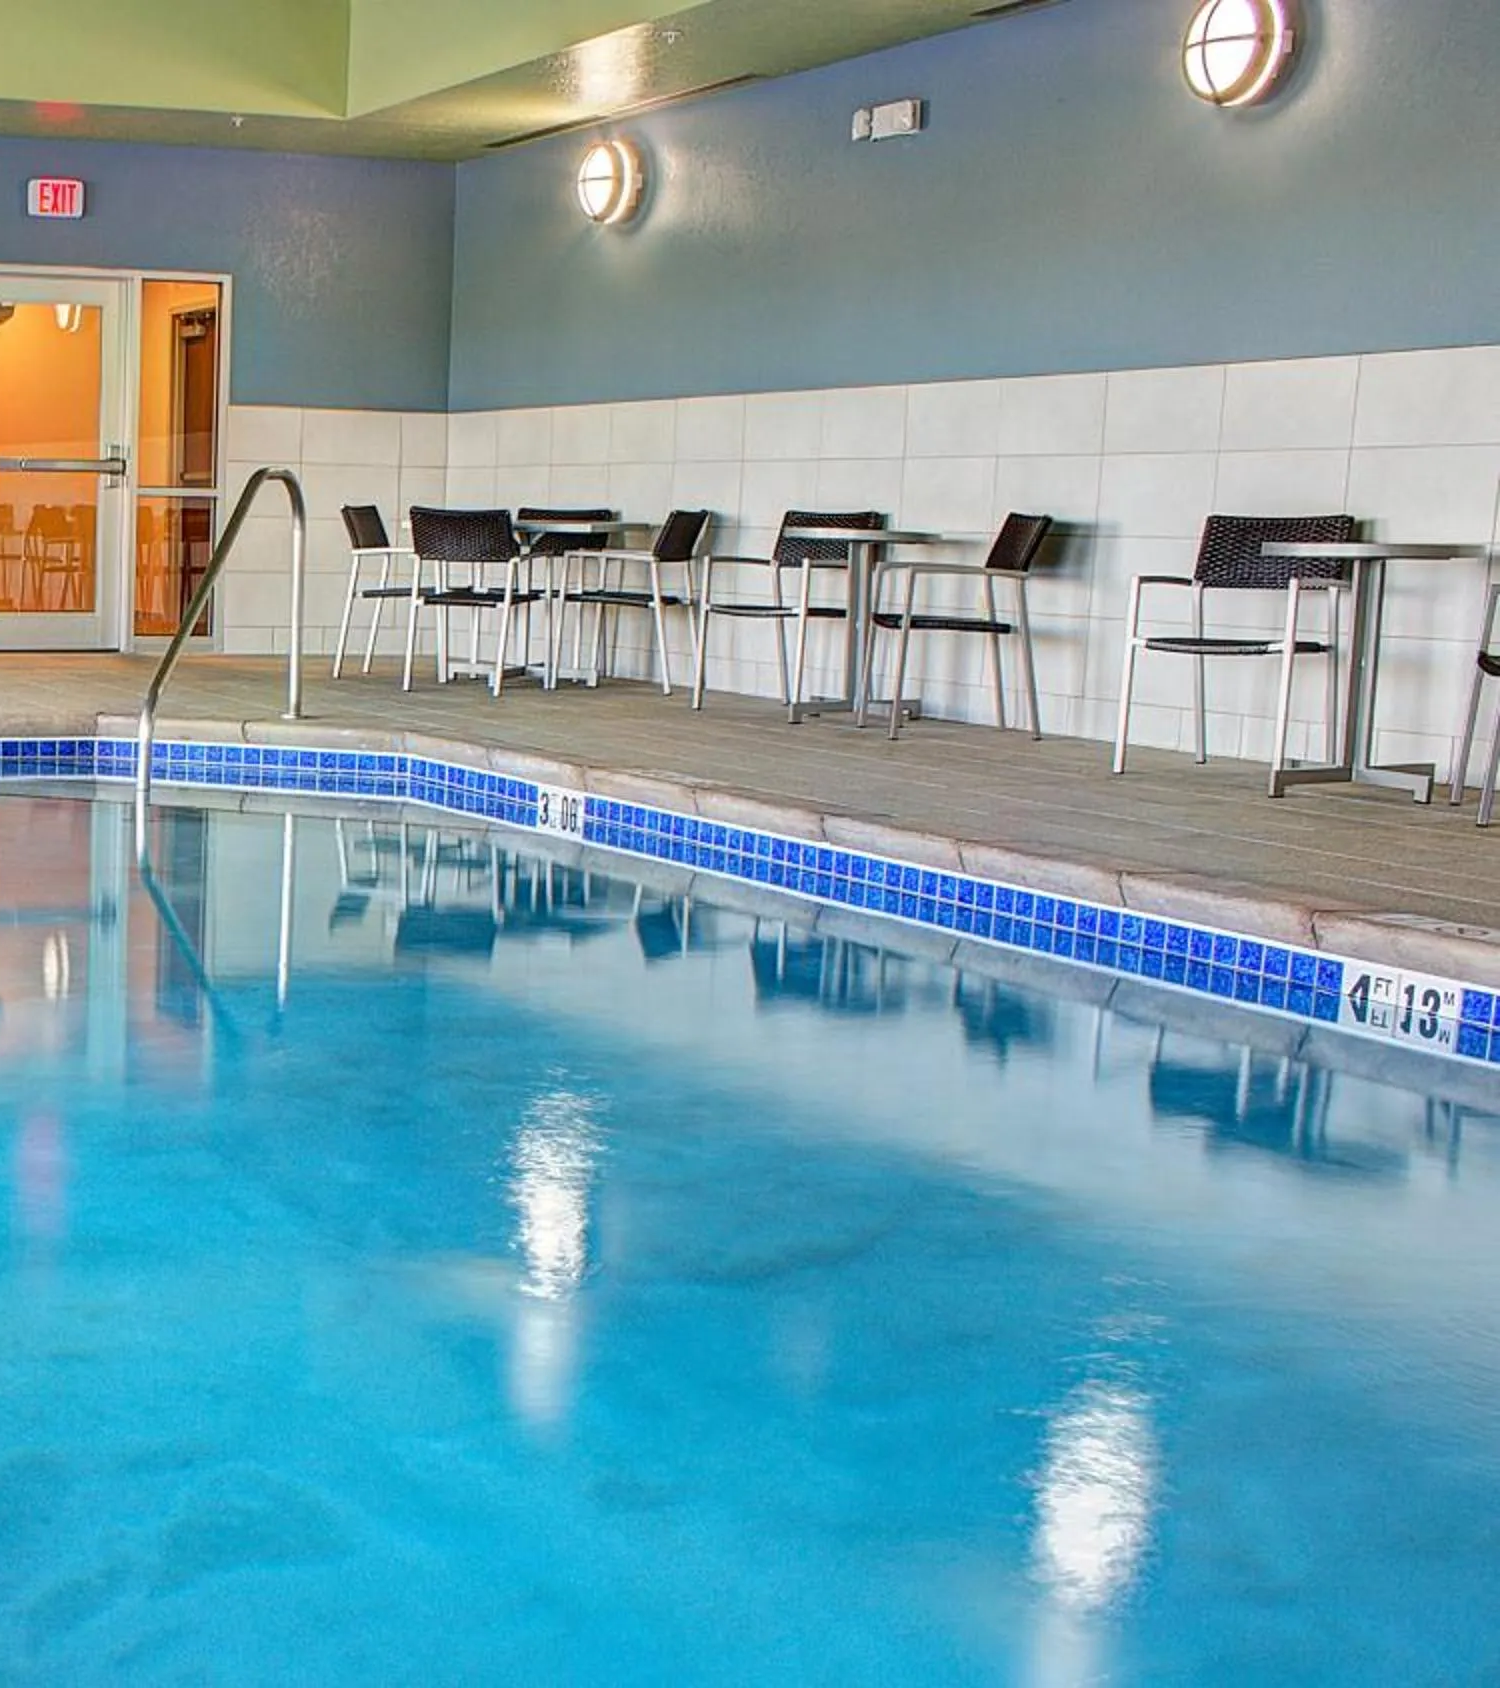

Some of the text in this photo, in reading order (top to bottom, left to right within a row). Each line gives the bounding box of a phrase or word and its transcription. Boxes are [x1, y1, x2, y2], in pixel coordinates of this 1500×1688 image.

[39, 182, 77, 214] EXIT
[540, 792, 549, 825] 3
[1347, 974, 1371, 1023] 4
[1374, 977, 1393, 997] FT
[1444, 991, 1455, 1007] M
